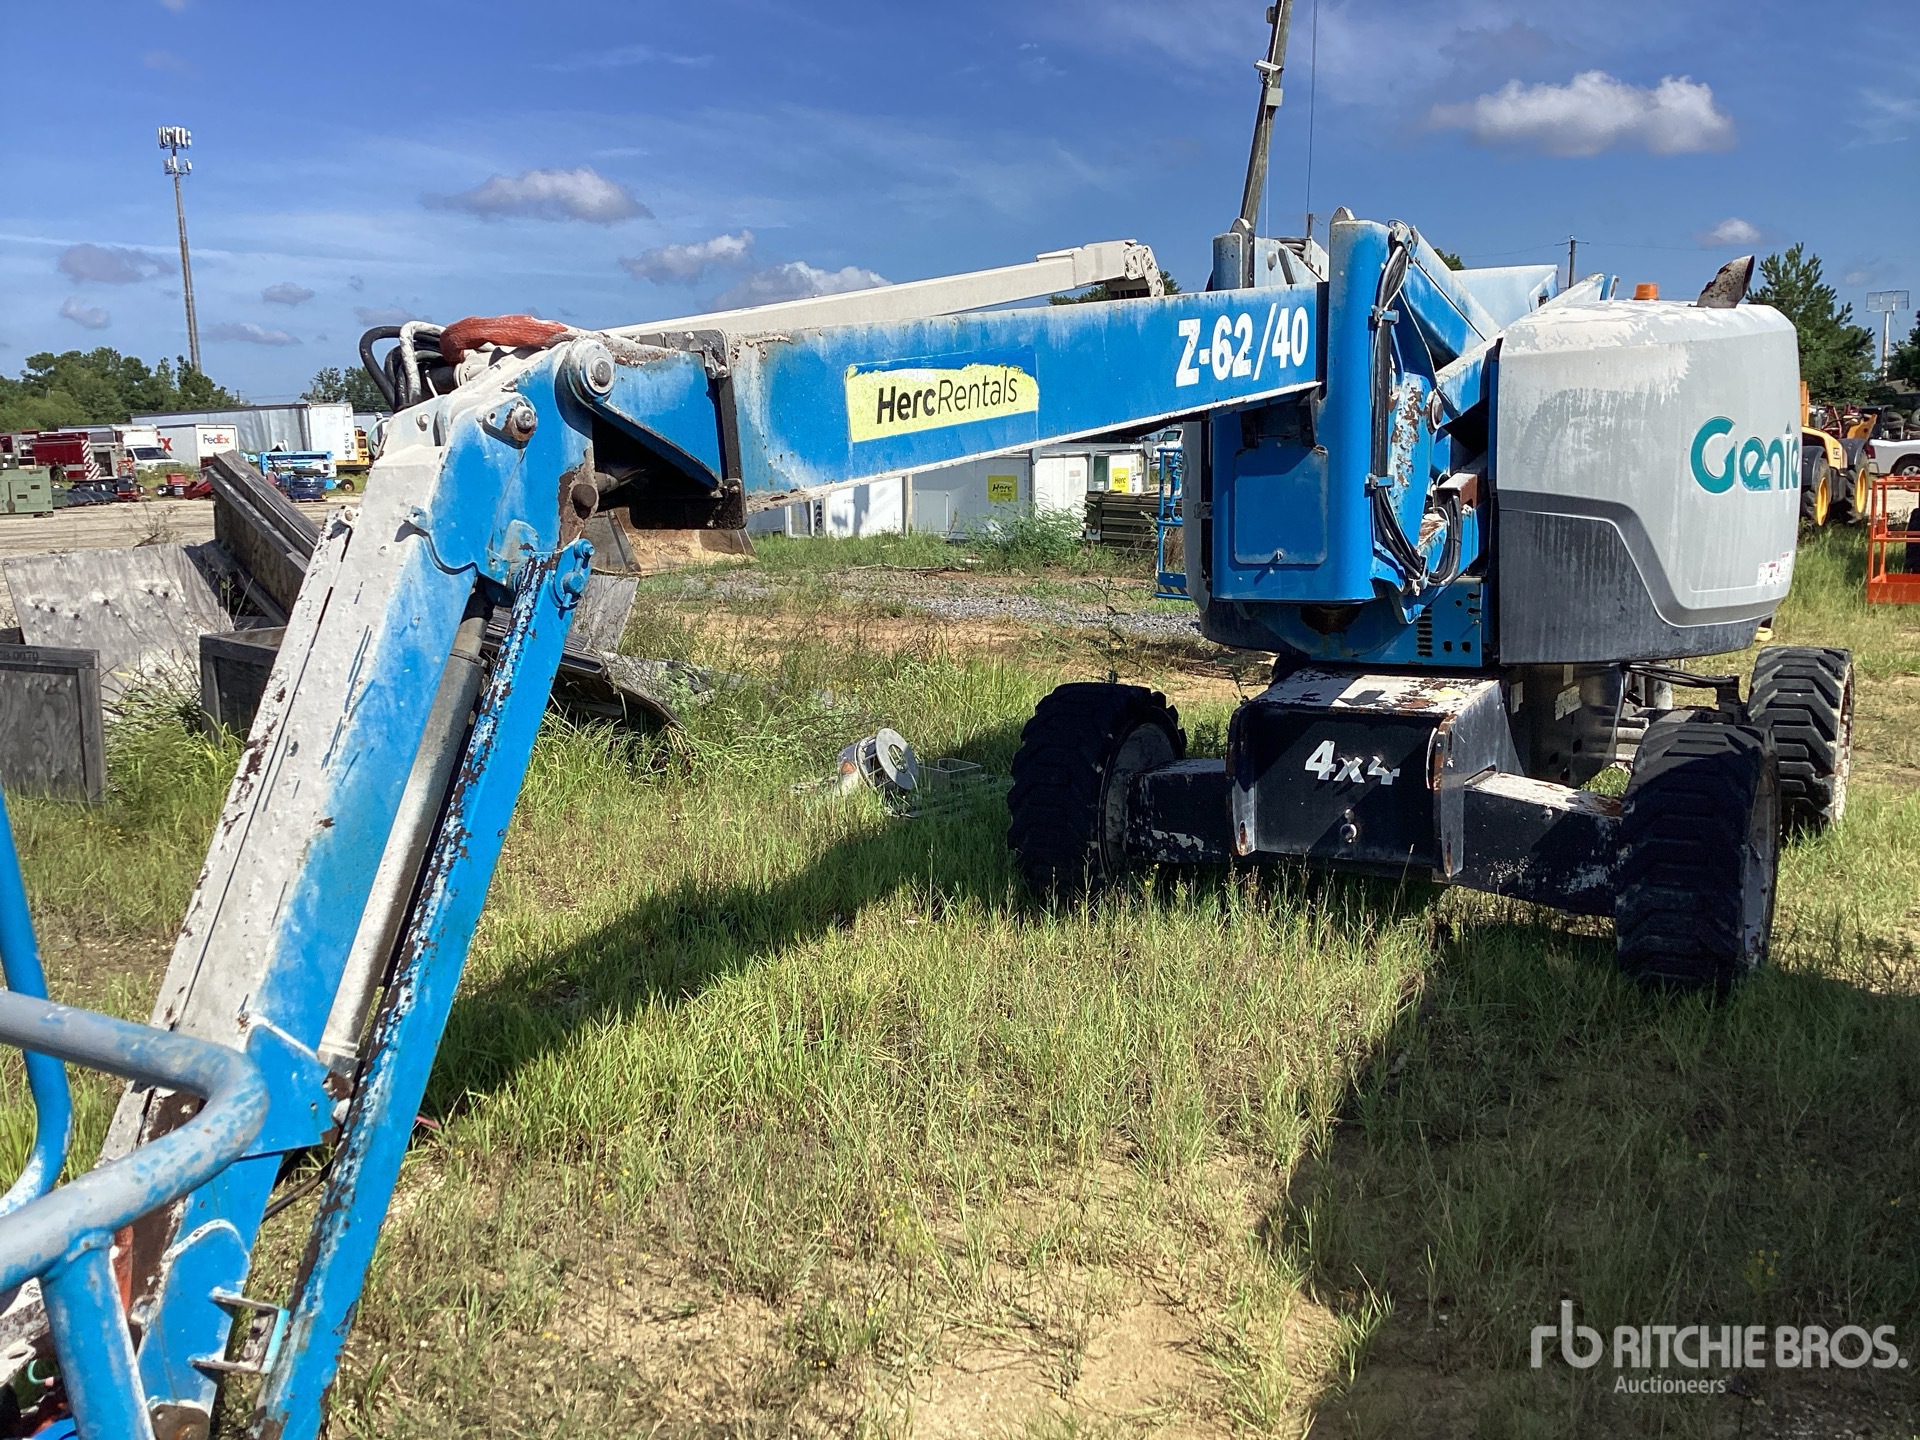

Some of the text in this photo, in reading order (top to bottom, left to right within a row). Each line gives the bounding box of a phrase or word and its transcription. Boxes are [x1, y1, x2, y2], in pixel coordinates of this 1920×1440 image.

[1176, 302, 1309, 388] Z-62/40
[876, 369, 1018, 425] HercRentals
[202, 434, 230, 444] FedEx
[1689, 415, 1800, 496] Genie
